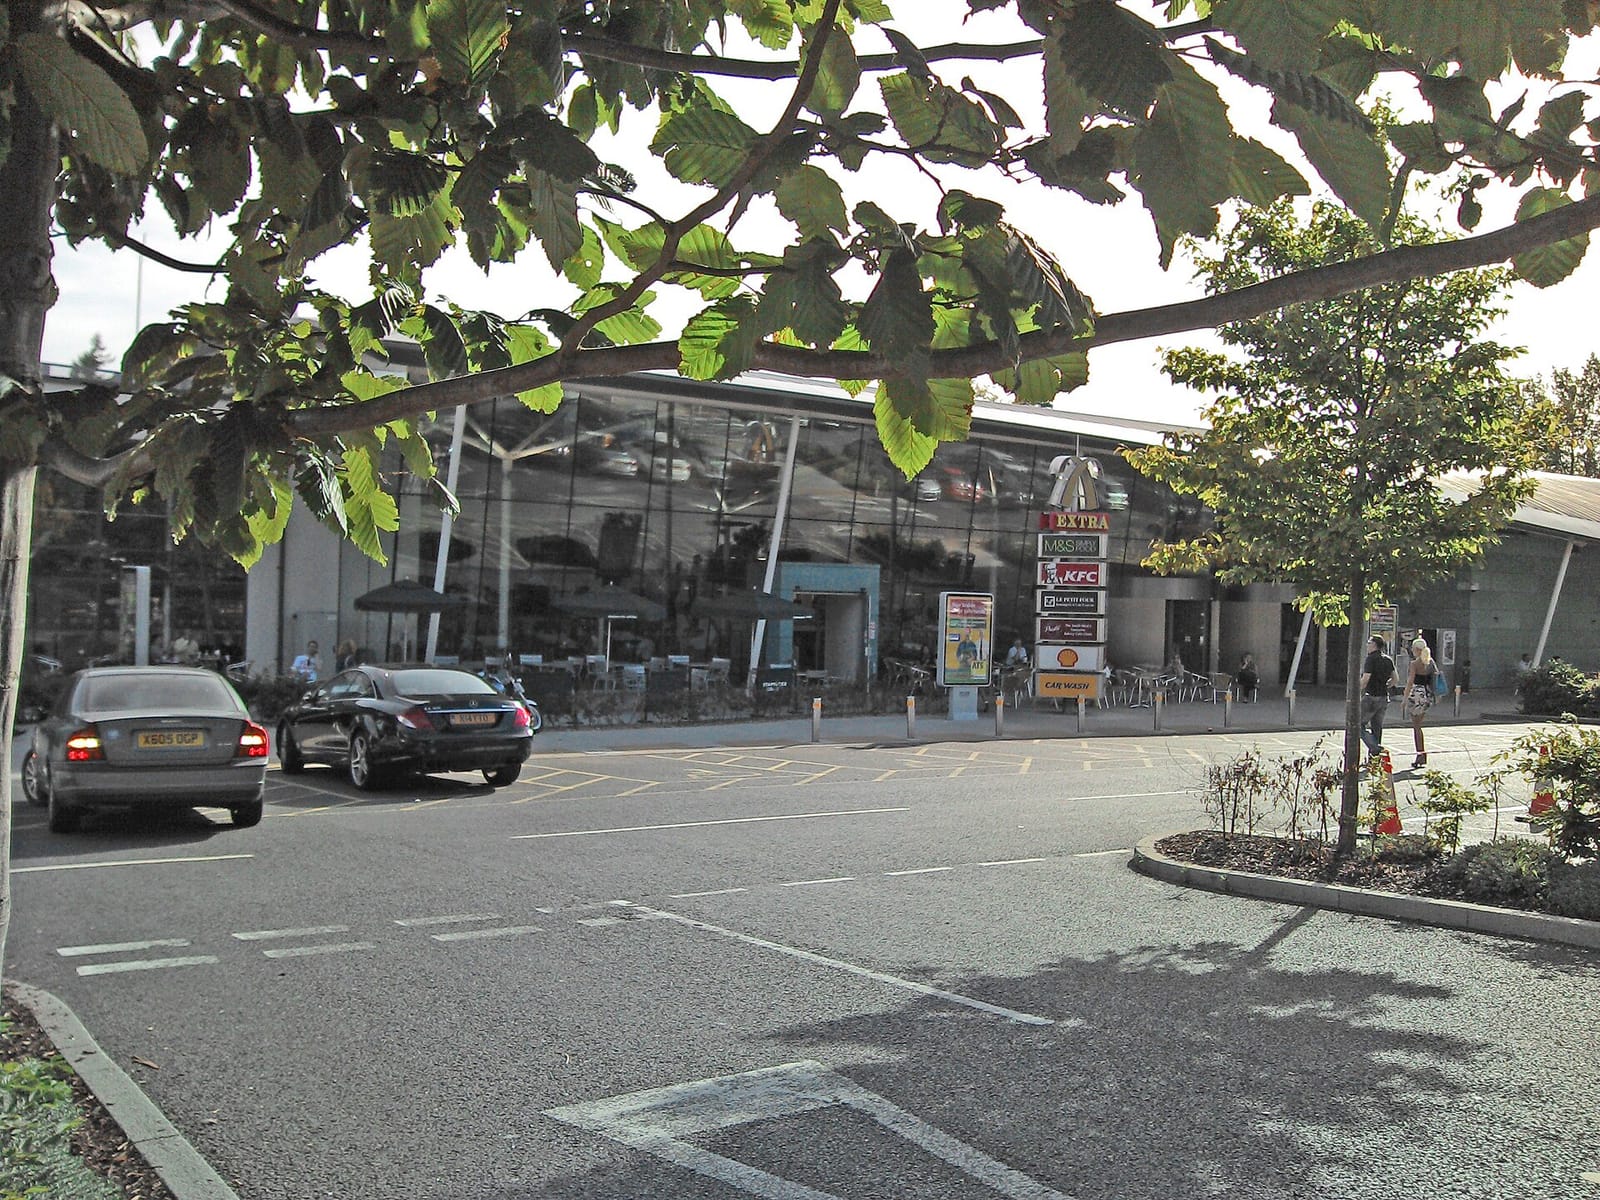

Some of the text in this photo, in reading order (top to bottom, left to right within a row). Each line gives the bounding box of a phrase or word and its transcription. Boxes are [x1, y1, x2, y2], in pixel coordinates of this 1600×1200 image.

[1056, 514, 1109, 529] EXTRA
[1044, 539, 1075, 552] M&S
[1063, 570, 1097, 582] KFC
[1063, 682, 1090, 690] WASH
